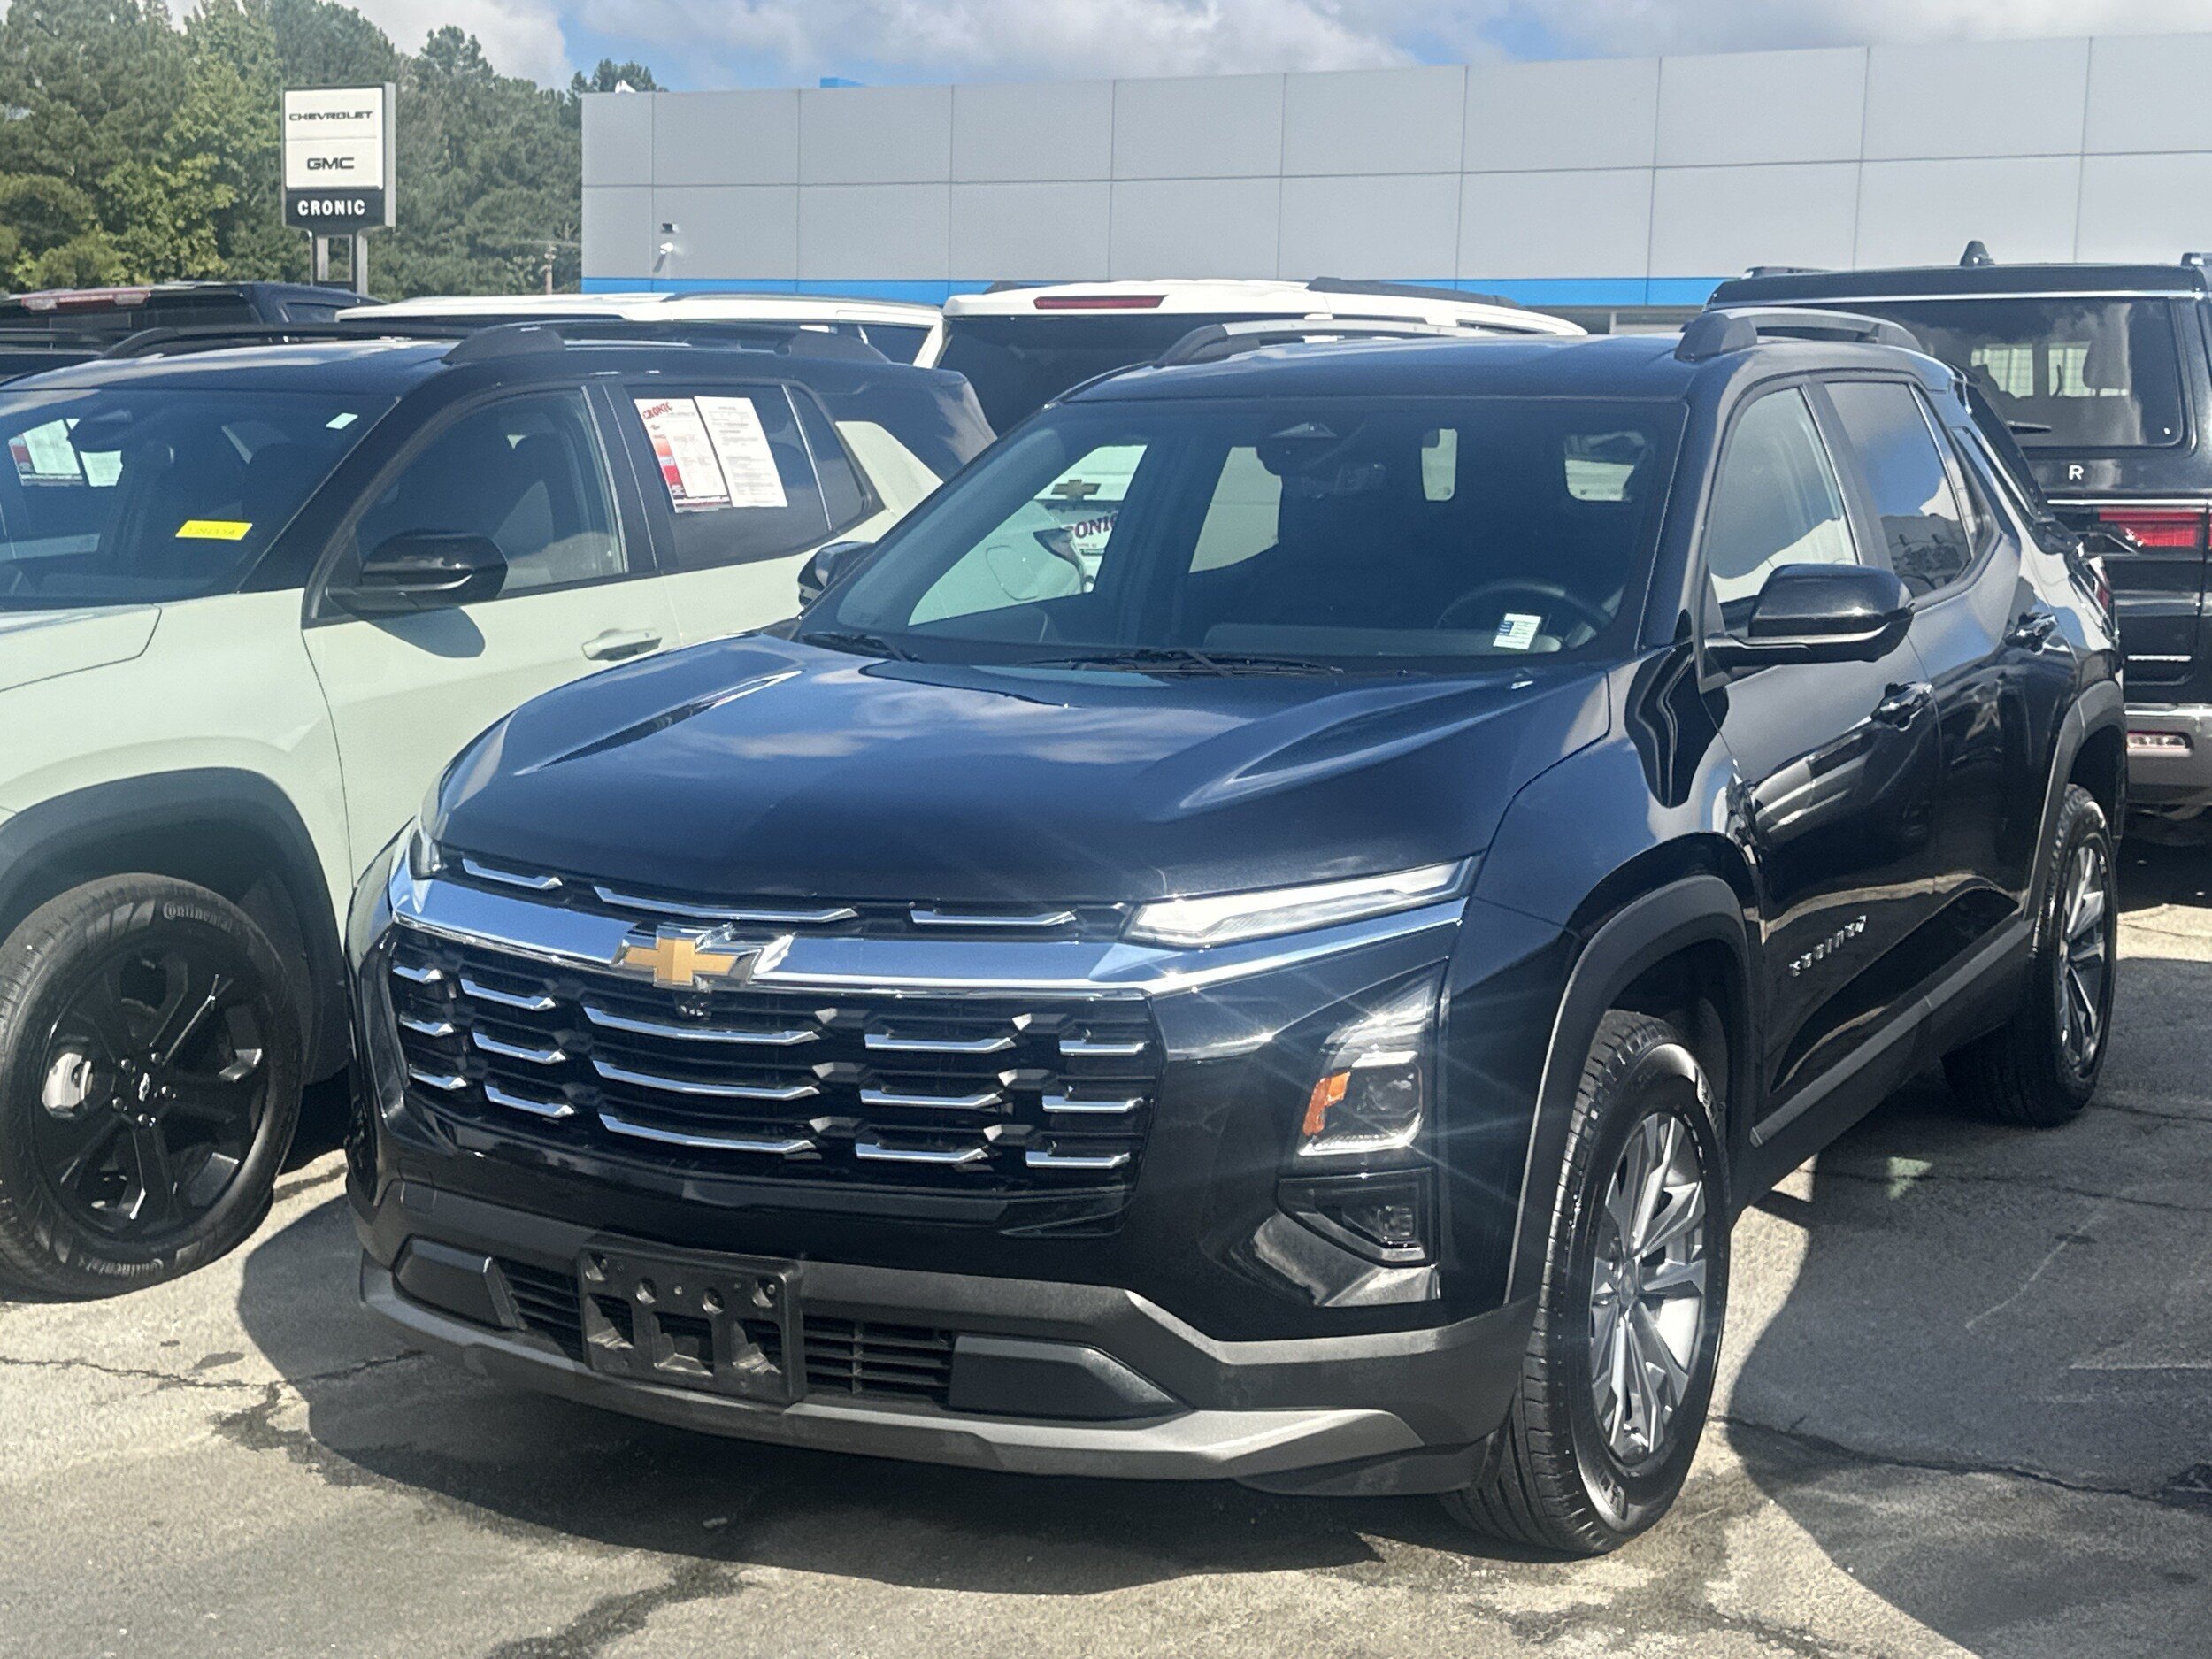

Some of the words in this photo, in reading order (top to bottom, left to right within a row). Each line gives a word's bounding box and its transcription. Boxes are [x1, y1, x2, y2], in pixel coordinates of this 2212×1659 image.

[288, 111, 373, 122] CHEVROLET
[306, 157, 355, 171] GMC
[297, 199, 365, 216] CRONIC
